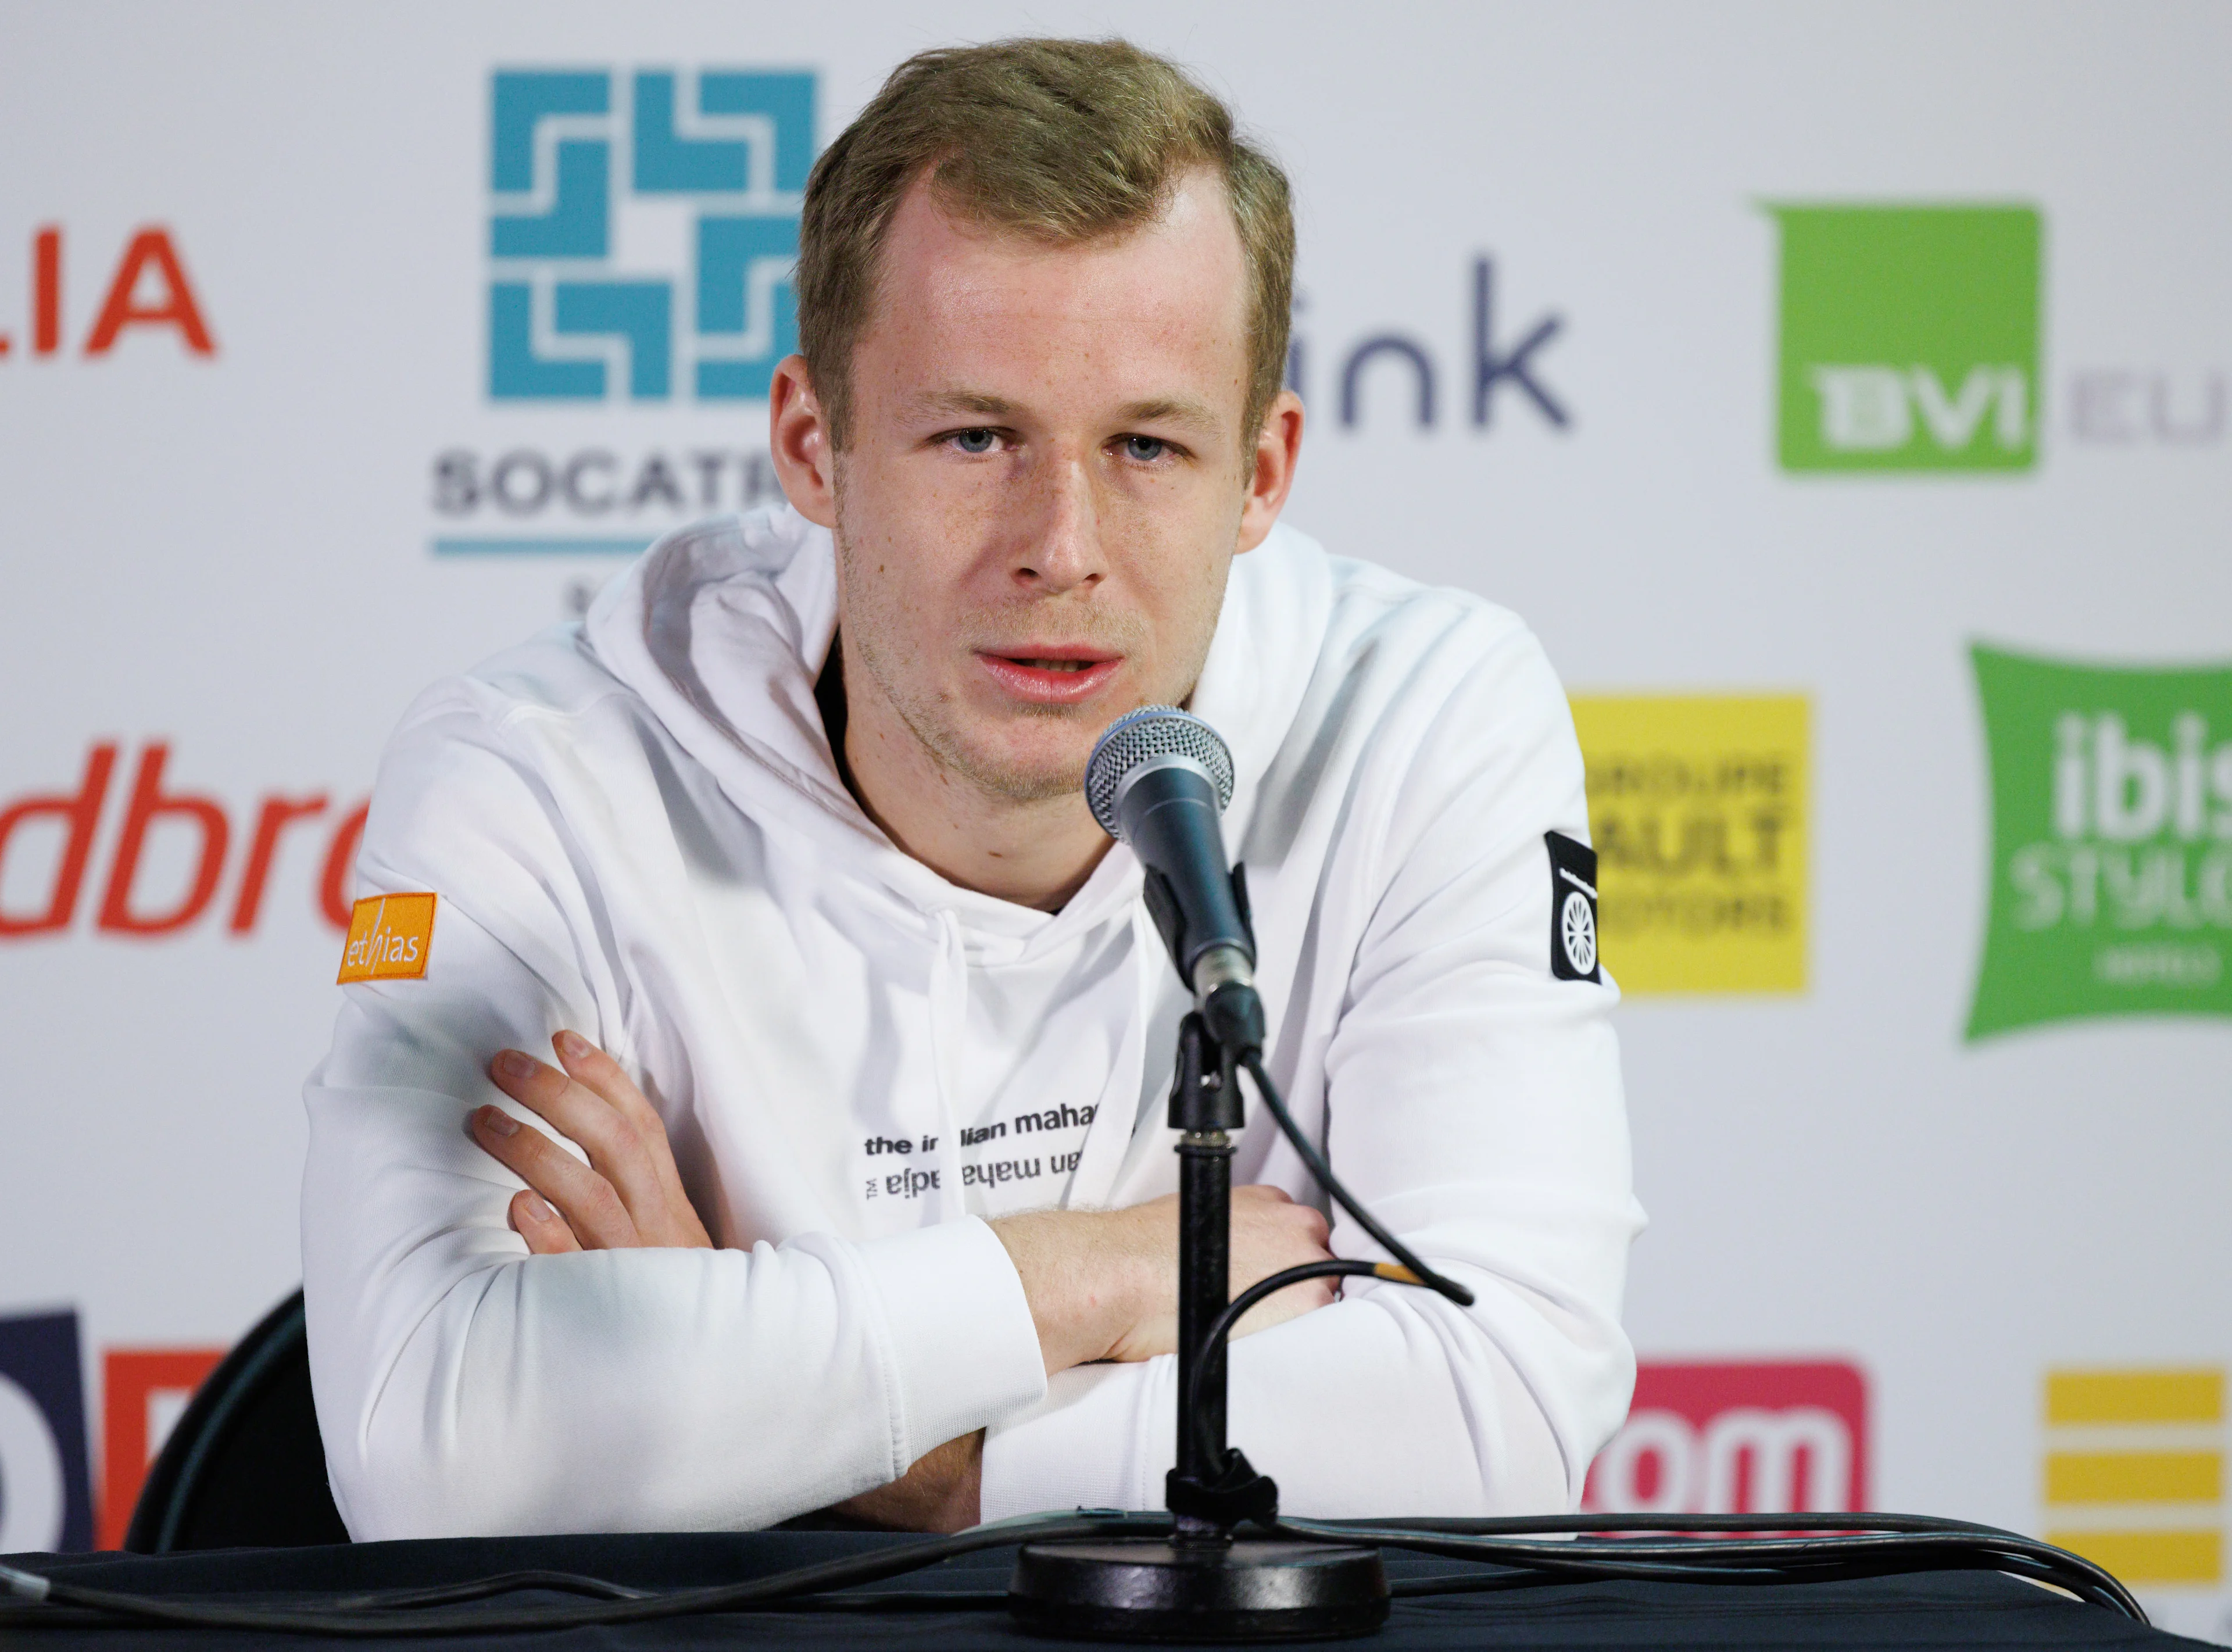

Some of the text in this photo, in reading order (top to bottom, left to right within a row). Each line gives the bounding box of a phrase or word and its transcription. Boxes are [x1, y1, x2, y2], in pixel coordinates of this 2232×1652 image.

[0, 226, 218, 359] IA
[1807, 364, 2031, 452] BVI
[348, 897, 419, 974] ethias
[865, 1136, 913, 1156] the
